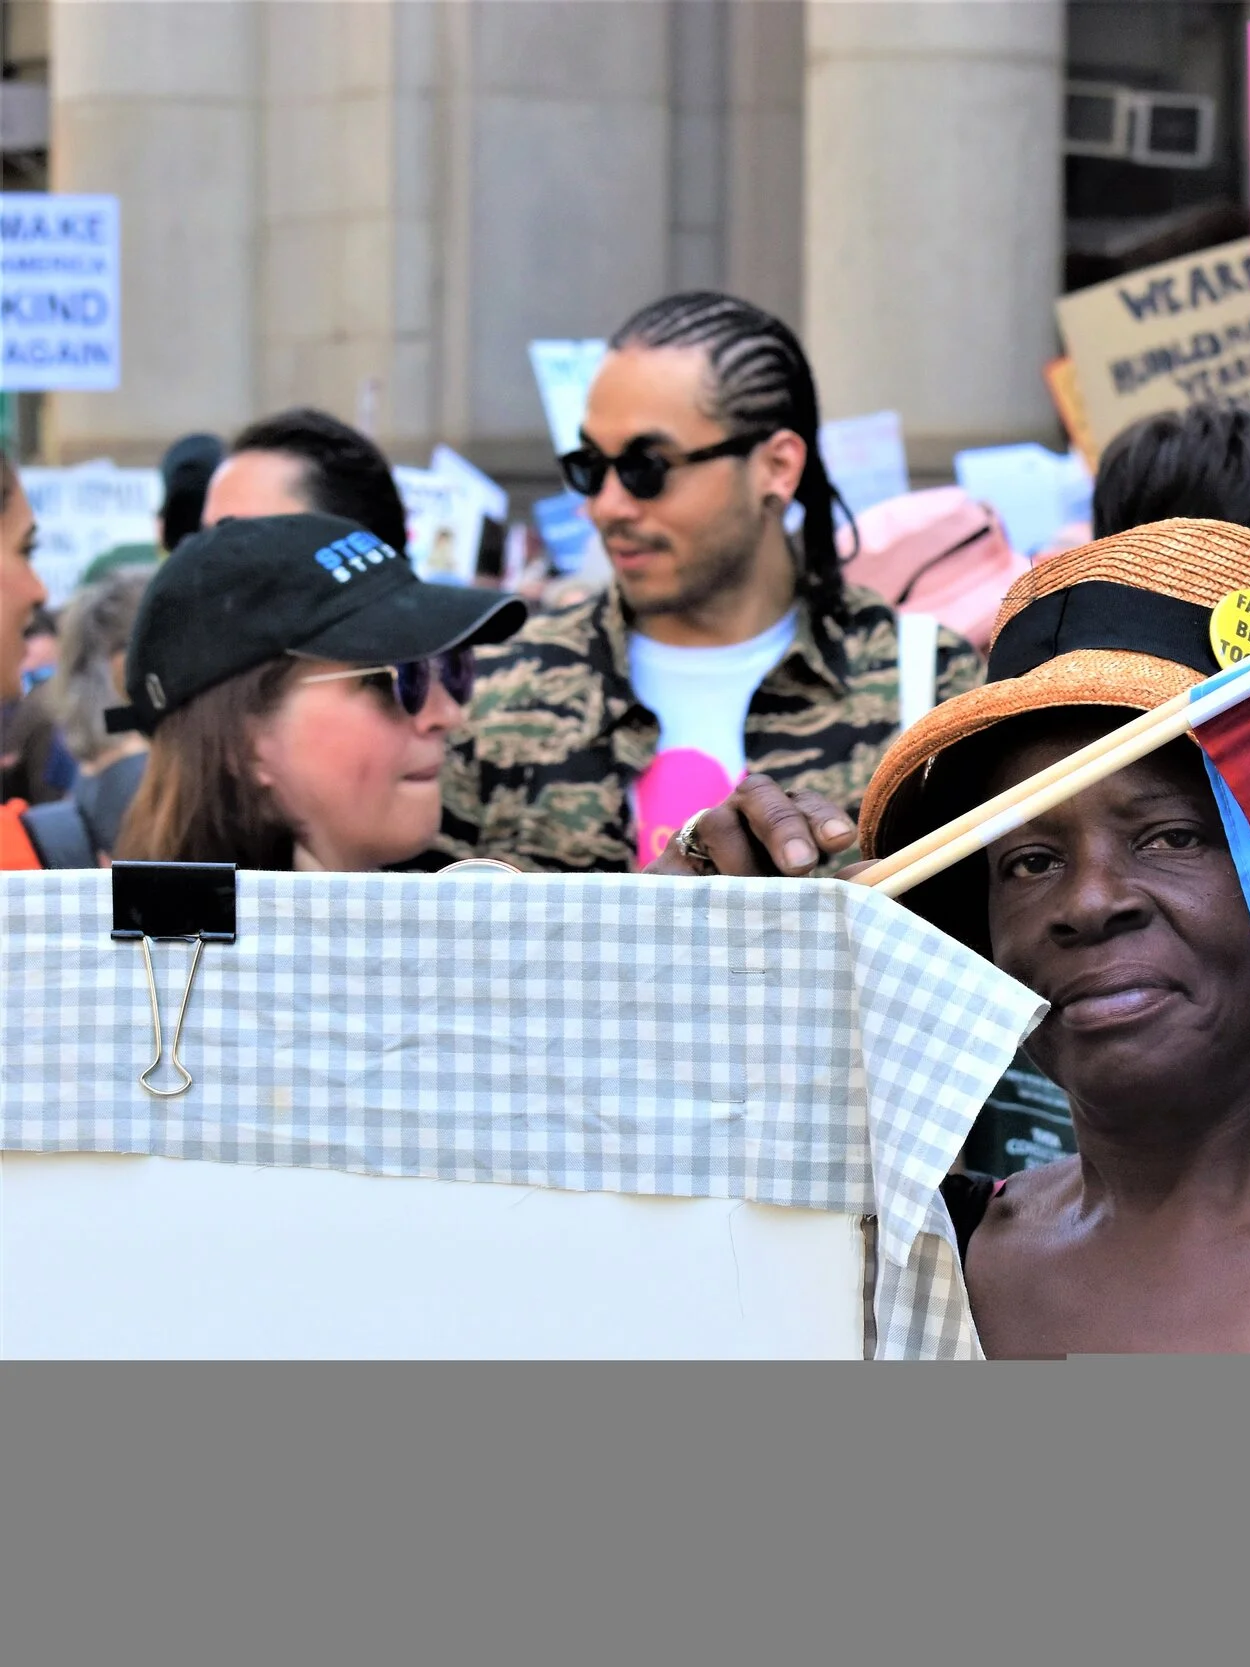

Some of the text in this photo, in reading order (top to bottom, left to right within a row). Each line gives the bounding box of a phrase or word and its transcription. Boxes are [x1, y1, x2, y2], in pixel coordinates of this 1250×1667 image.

[0, 212, 105, 244] MAKE
[0, 289, 108, 327] KIND
[1117, 276, 1183, 322] WE
[4, 338, 110, 366] AGAIN
